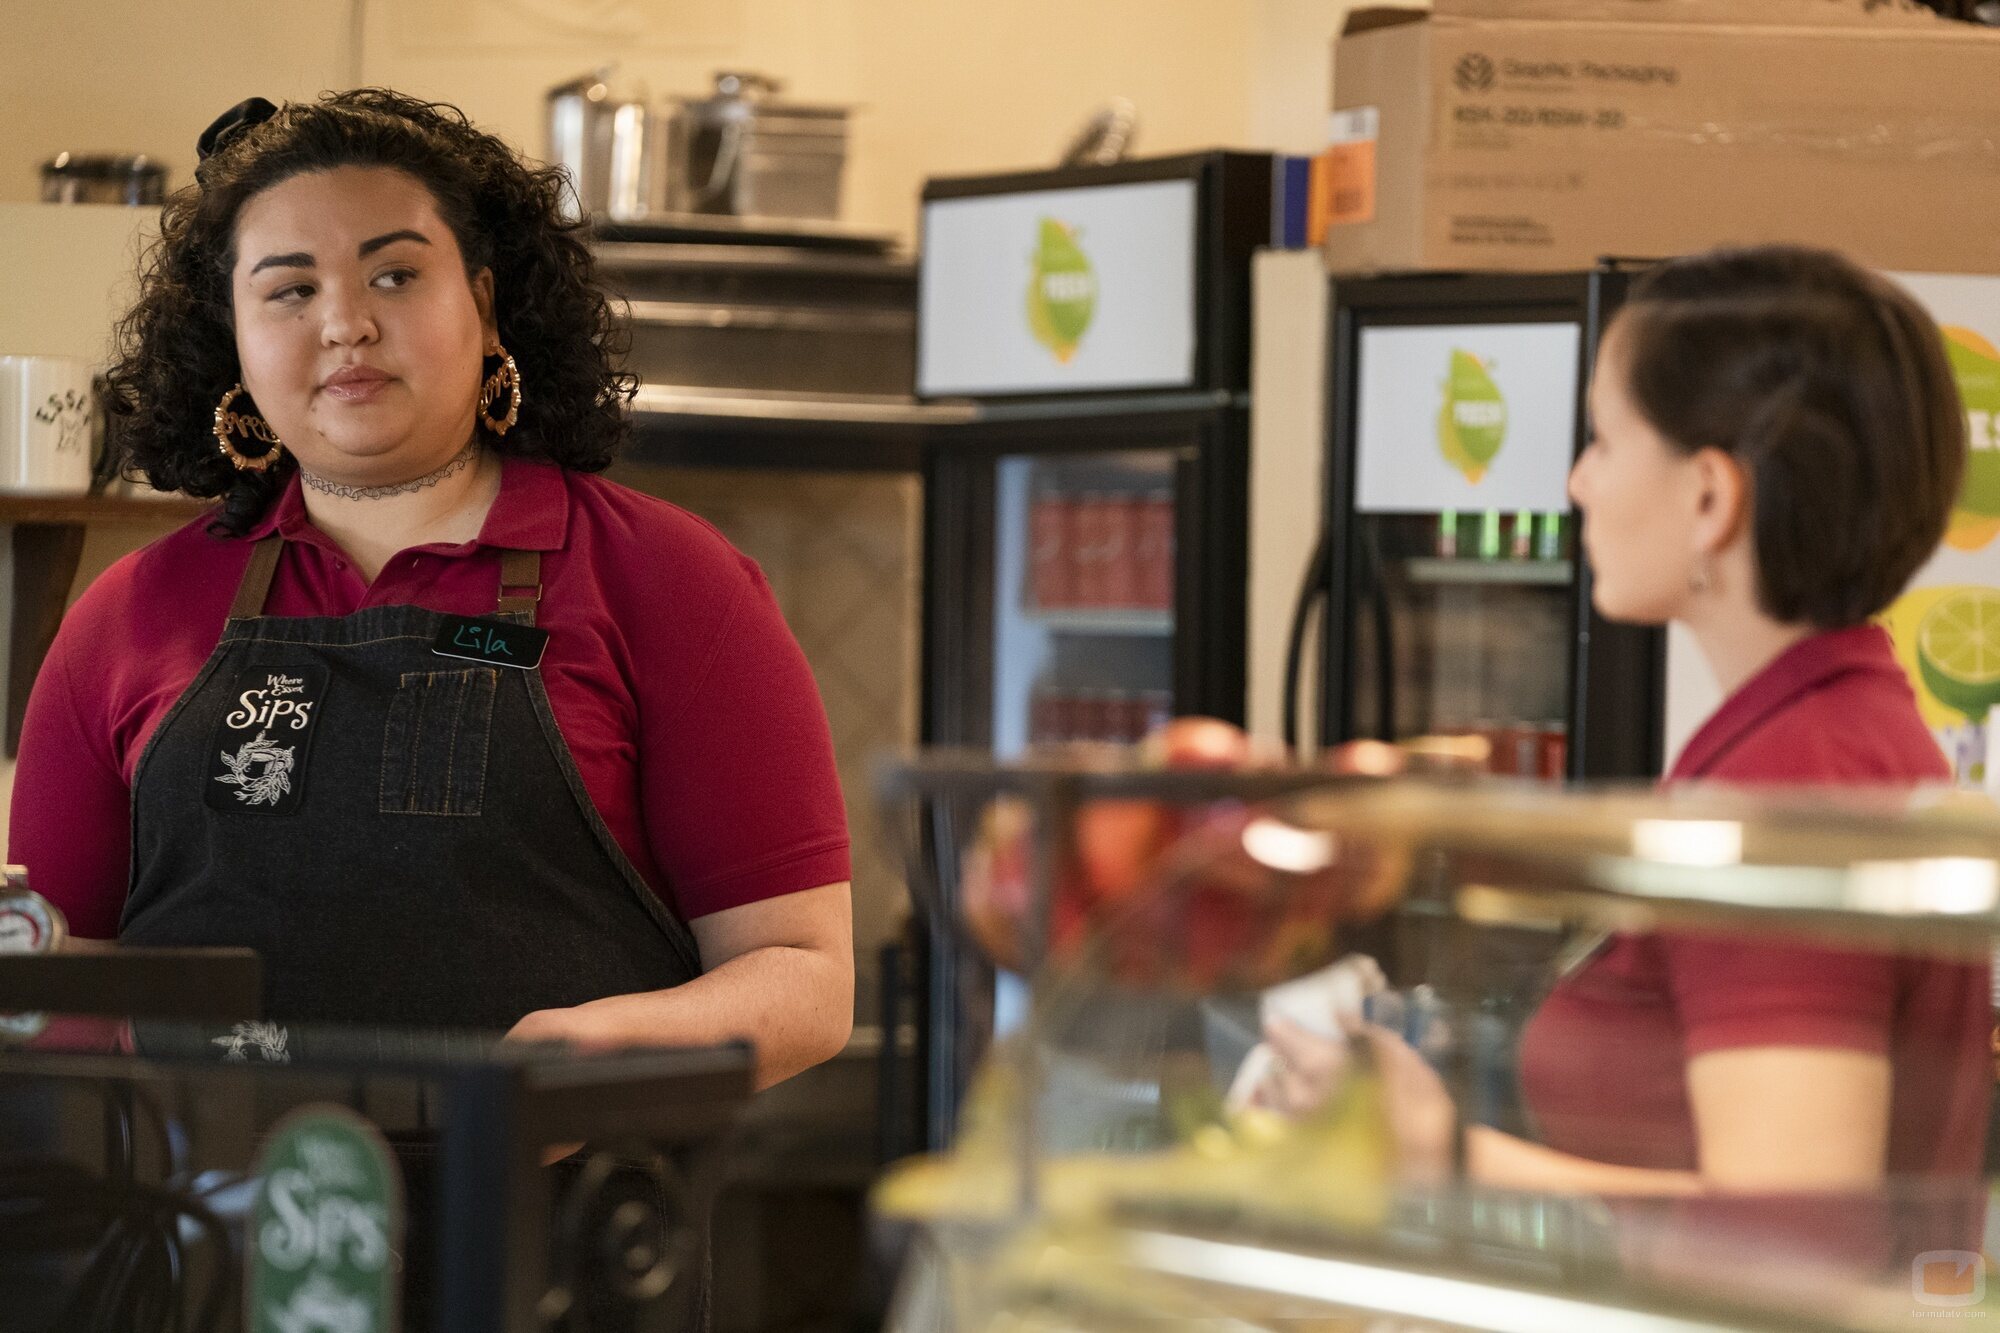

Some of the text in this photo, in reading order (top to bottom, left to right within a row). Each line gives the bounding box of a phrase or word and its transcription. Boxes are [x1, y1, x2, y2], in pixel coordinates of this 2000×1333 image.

[453, 624, 513, 656] Lila
[266, 673, 303, 686] Where
[226, 689, 314, 730] Sips
